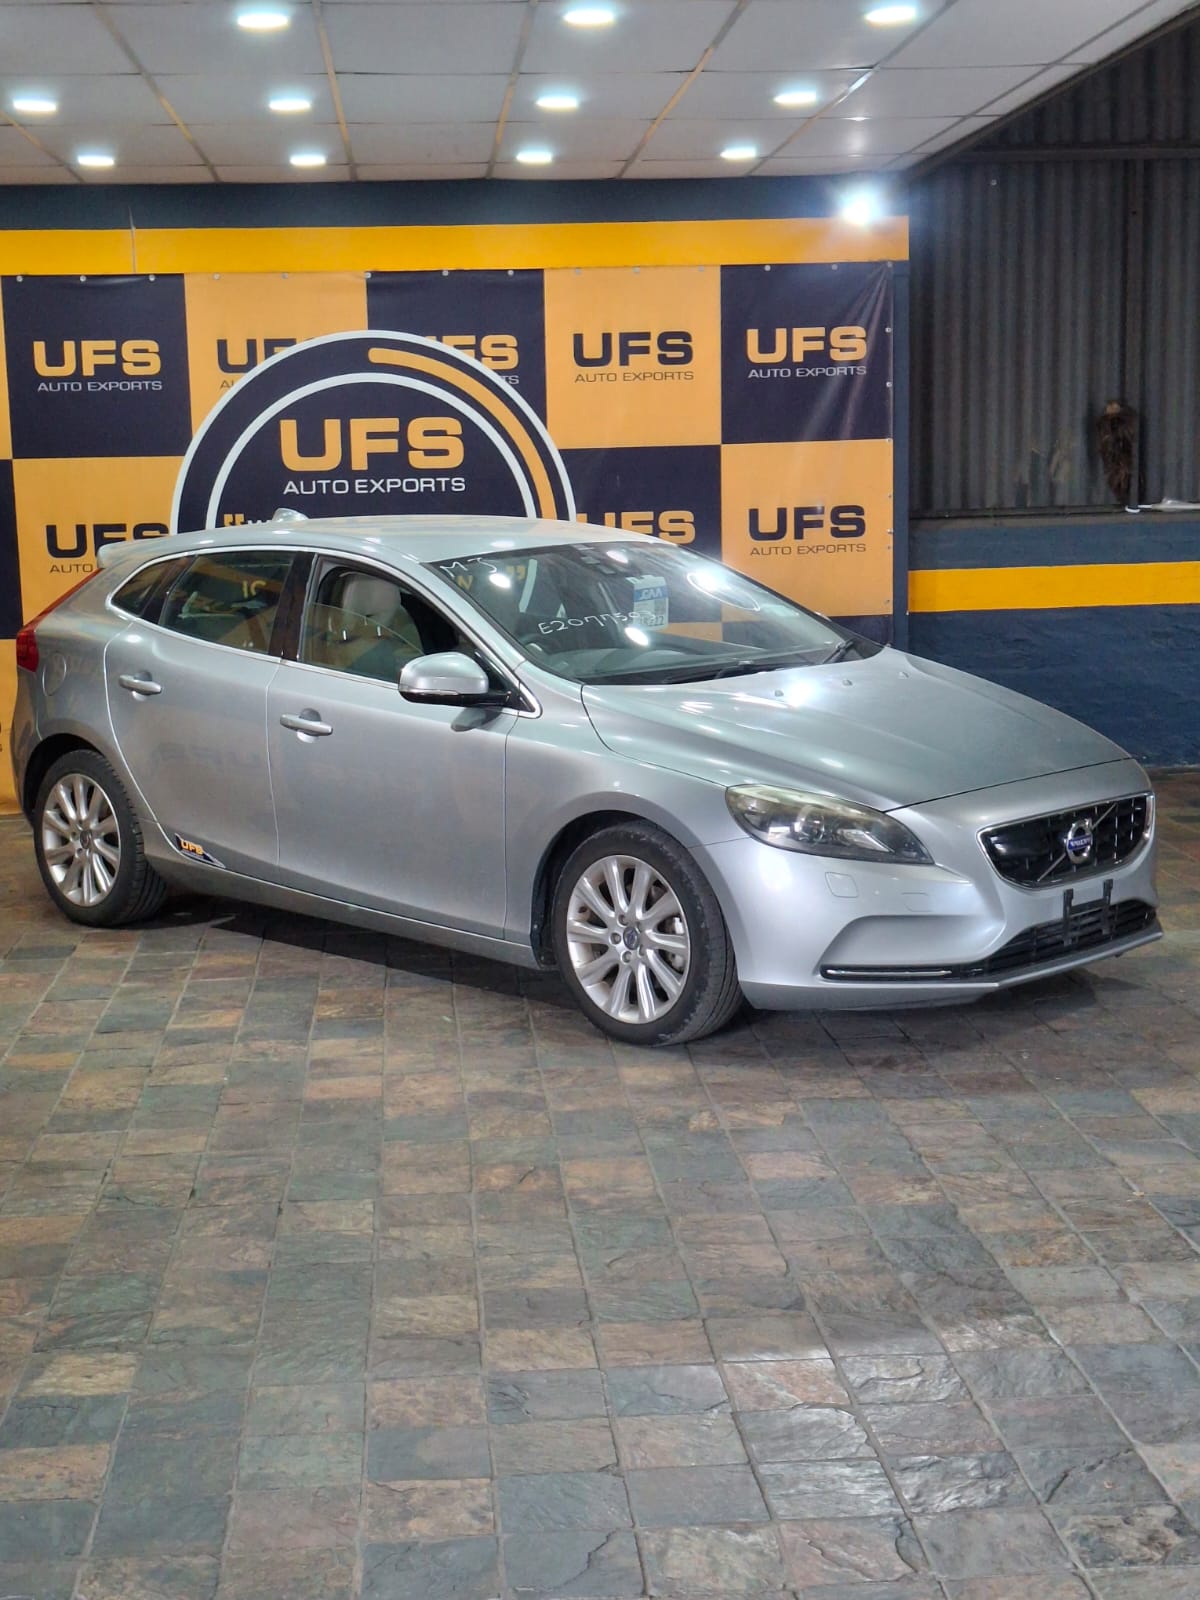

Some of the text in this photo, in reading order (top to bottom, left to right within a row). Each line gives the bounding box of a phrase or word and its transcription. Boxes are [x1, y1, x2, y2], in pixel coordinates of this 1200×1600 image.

[33, 340, 161, 376] UFS
[217, 338, 297, 373] UF
[424, 335, 519, 370] FS
[573, 331, 693, 367] UFS
[746, 326, 867, 363] UFS
[37, 380, 163, 392] AUTO EXPORTS
[575, 371, 694, 383] AUTO EXPORTS
[748, 366, 867, 379] AUTO EXPORTS
[279, 416, 465, 471] UFS
[283, 477, 466, 495] AUTO EXPORTS
[748, 505, 866, 541] UFS
[750, 543, 867, 556] AUTO EXPORTS
[49, 563, 93, 573] AUTO
